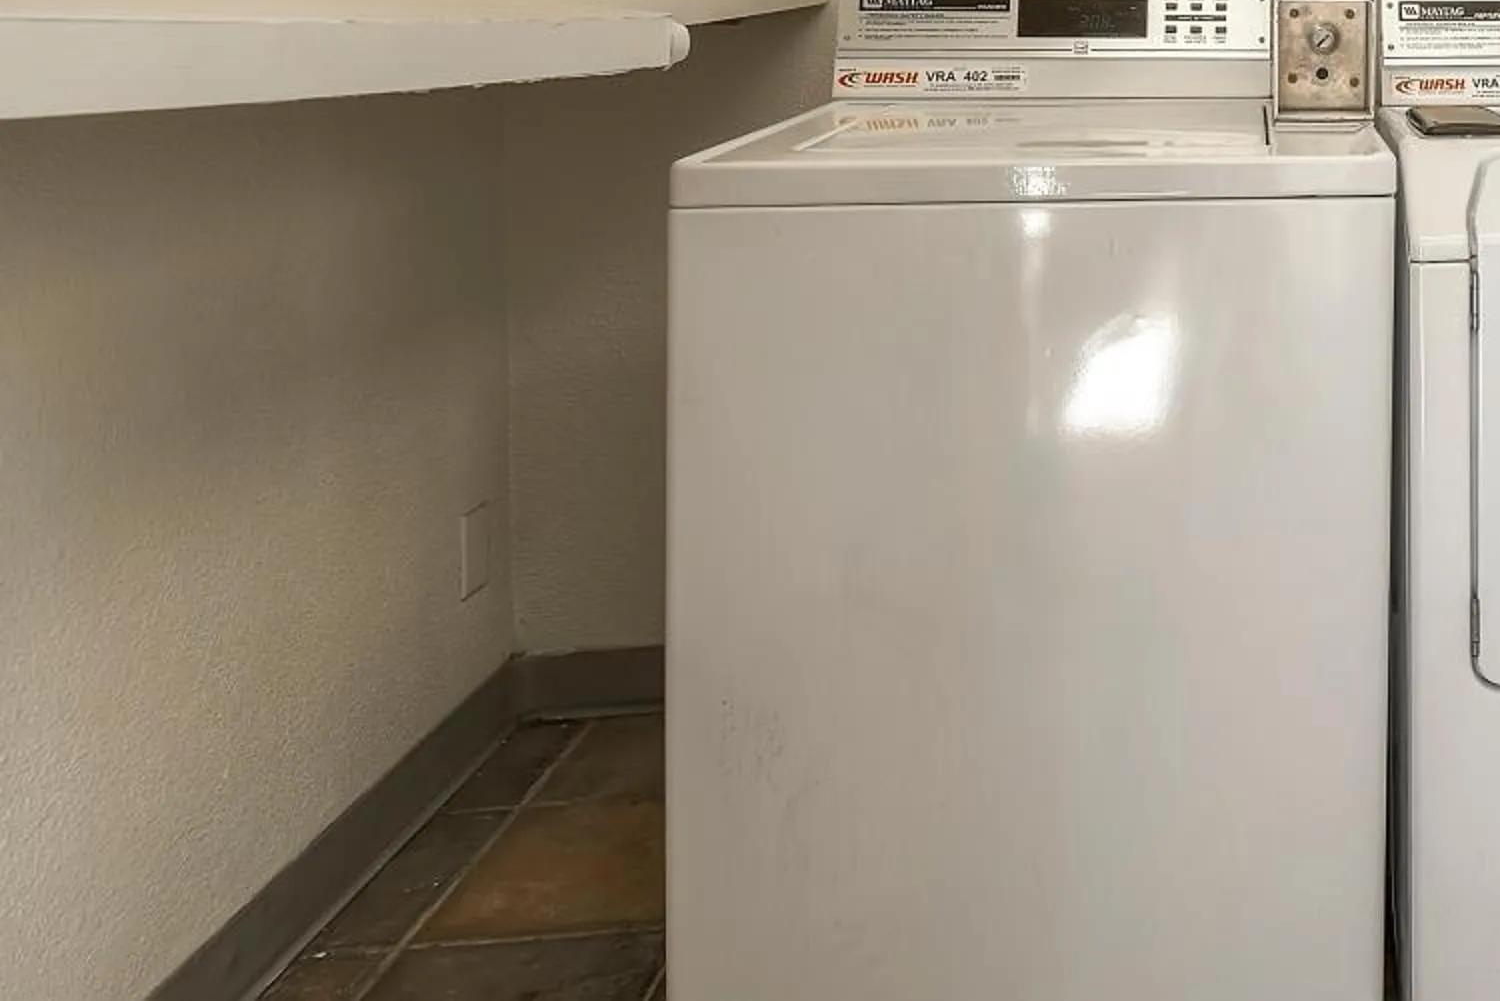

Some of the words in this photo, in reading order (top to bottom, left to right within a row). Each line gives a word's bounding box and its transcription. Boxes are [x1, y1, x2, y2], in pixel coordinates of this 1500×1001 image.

[1421, 6, 1465, 16] MAYTAG
[864, 71, 919, 84] WASH
[925, 71, 956, 82] VRA
[963, 70, 988, 82] 402
[1418, 78, 1465, 90] WASH
[1472, 78, 1499, 88] VRA
